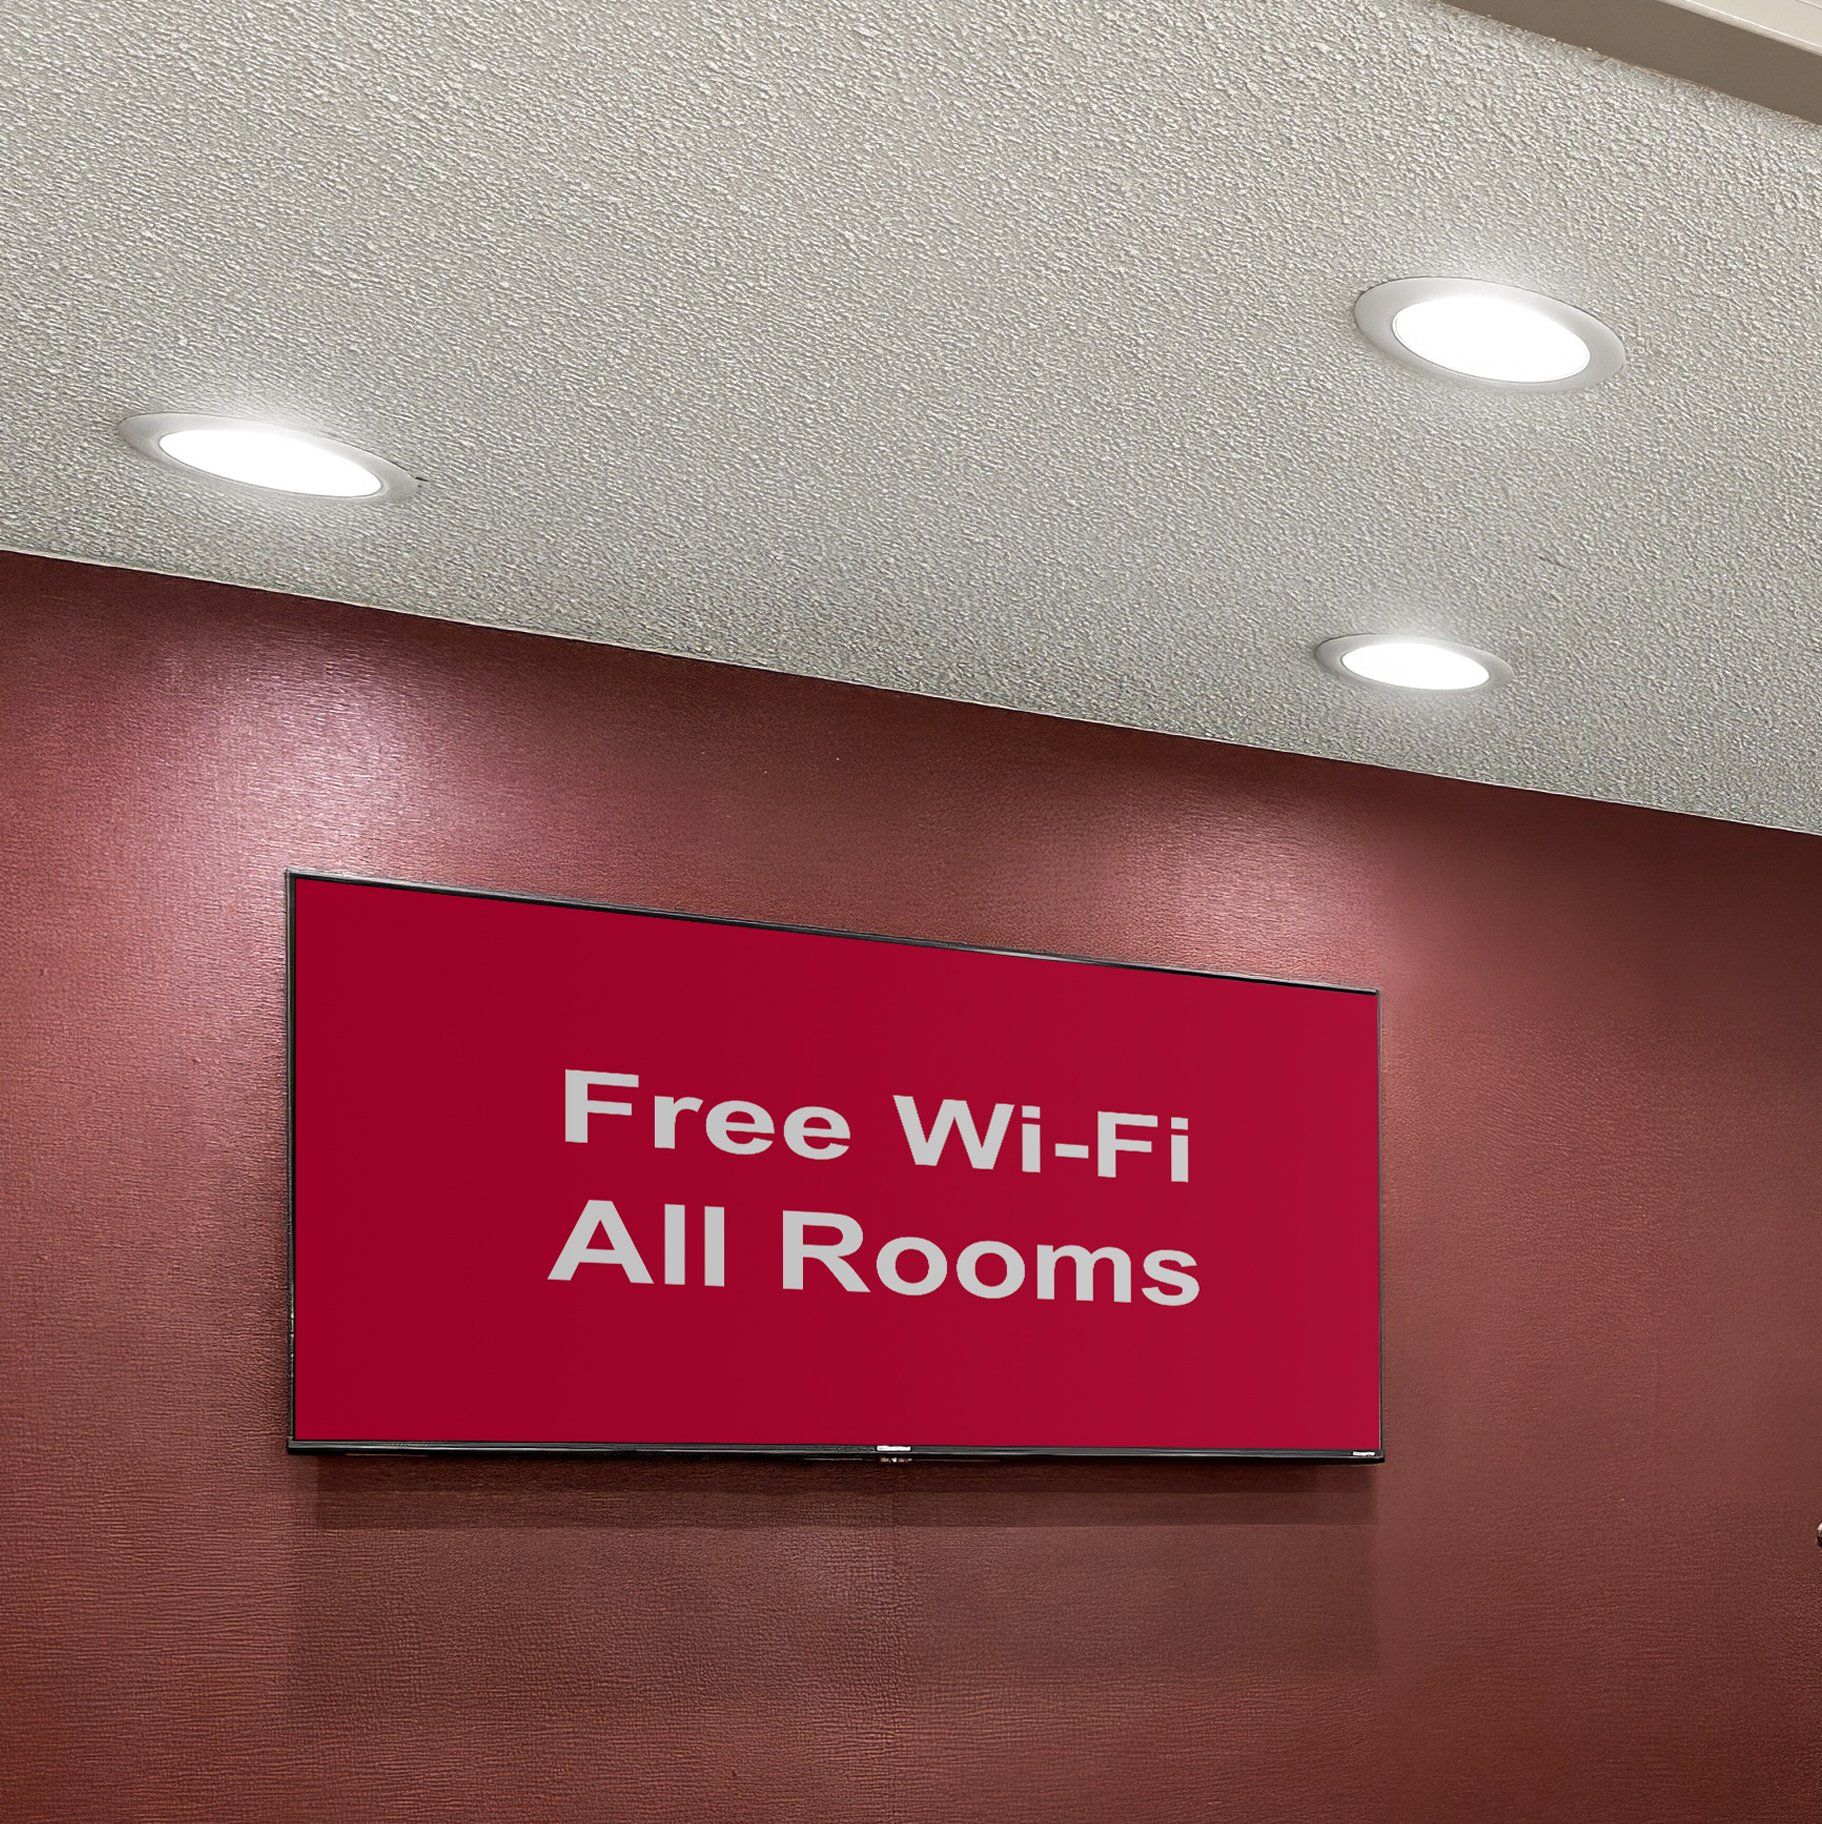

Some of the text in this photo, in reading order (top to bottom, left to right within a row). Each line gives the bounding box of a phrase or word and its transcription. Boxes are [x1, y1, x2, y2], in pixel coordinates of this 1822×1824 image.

[565, 1069, 1189, 1183] Free Wi-Fi
[548, 1200, 1200, 1307] All Rooms
